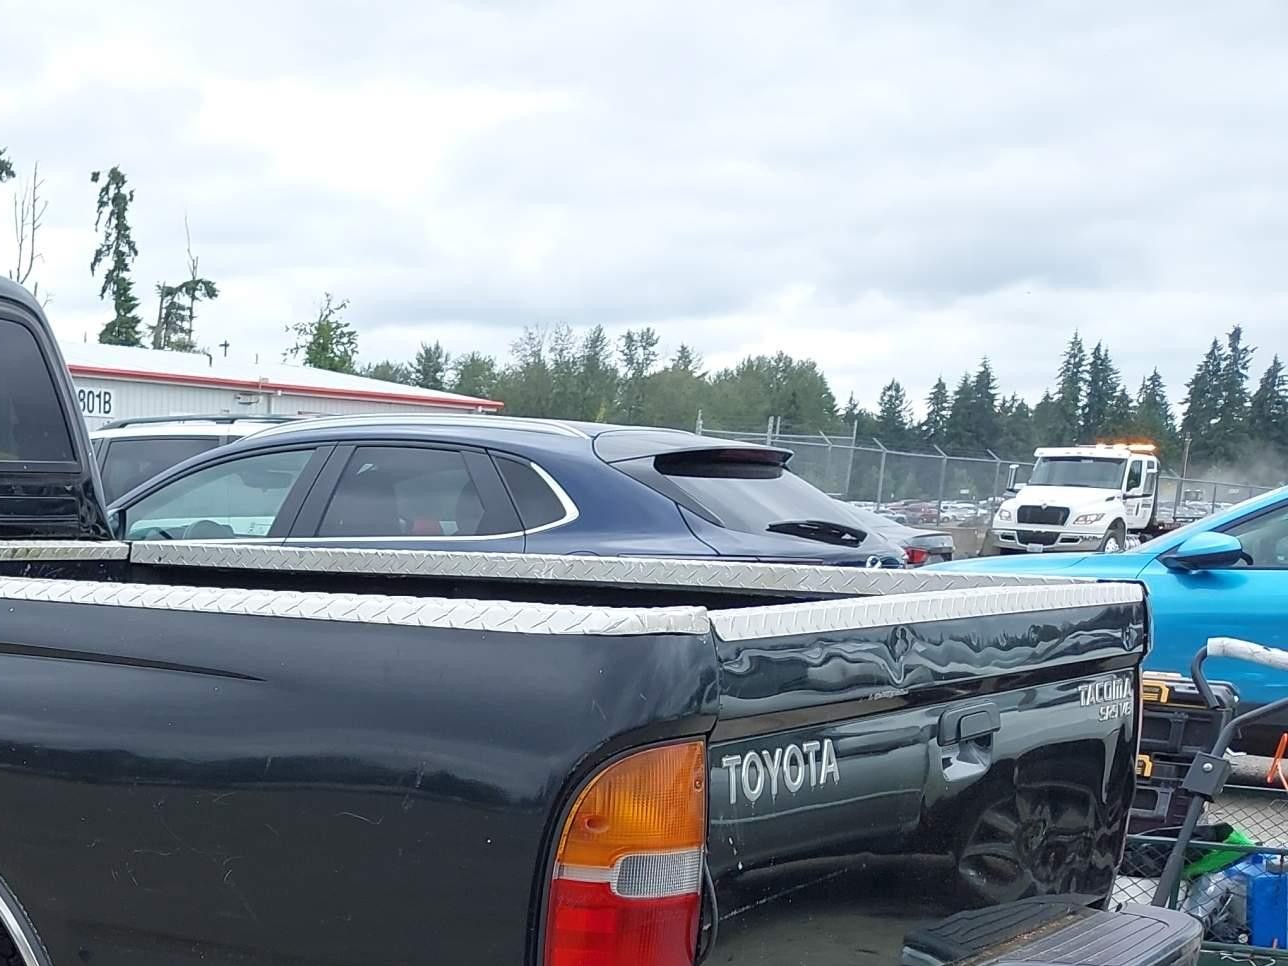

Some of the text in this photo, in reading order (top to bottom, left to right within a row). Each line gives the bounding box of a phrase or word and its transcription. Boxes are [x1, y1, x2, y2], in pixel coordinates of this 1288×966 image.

[1078, 677, 1132, 706] TACOMA
[1098, 702, 1119, 721] SR5
[721, 737, 840, 804] TOYOTA
